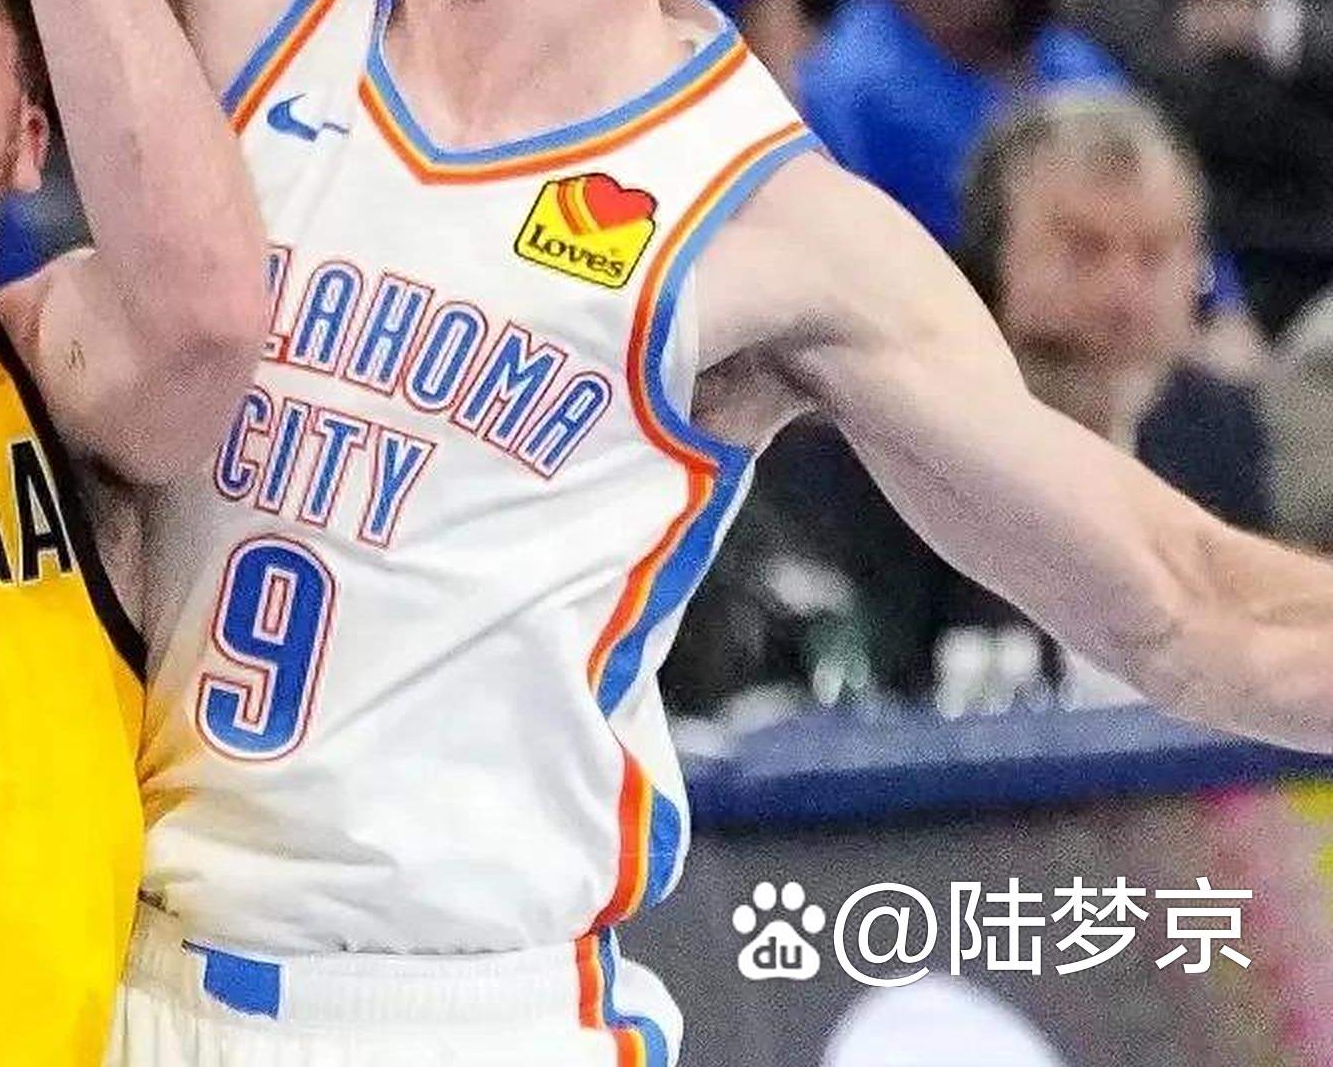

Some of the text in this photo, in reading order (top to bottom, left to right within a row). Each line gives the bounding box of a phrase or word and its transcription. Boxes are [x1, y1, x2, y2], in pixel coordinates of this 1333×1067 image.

[213, 383, 438, 548] CITY
[259, 245, 613, 481] LAHOMA
[195, 534, 337, 762] 9
